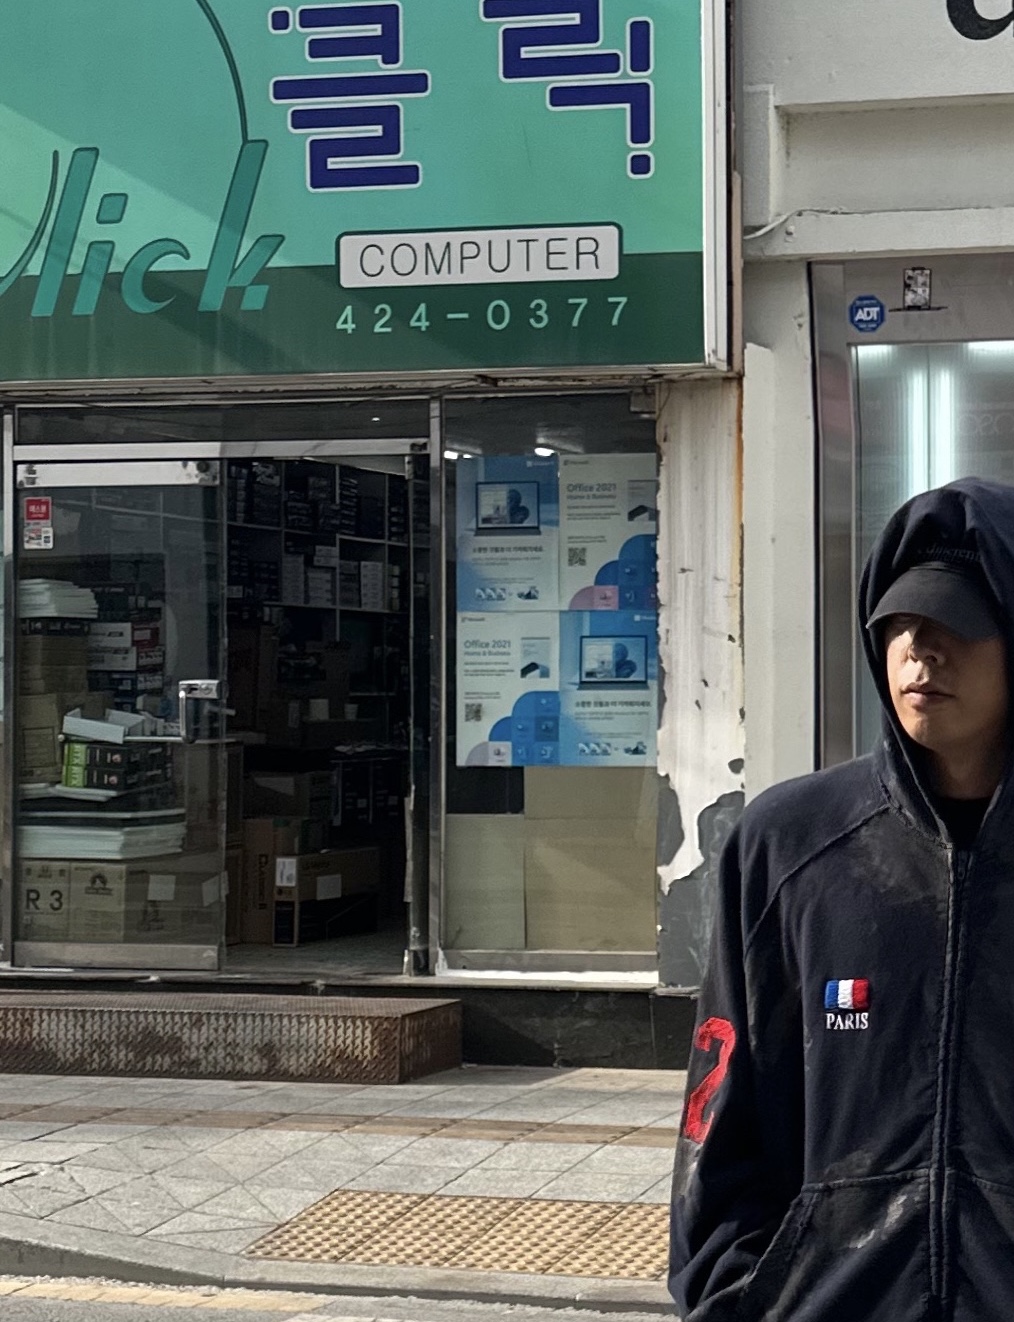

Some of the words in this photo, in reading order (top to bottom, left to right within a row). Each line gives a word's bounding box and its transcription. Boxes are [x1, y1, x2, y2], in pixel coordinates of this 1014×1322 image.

[0, 139, 285, 317] lick
[359, 236, 600, 278] COMPUTER
[335, 296, 628, 334] 424-0377
[855, 307, 880, 321] ADT
[566, 483, 594, 493] Office
[595, 483, 617, 493] 2021
[464, 640, 490, 649] Office
[491, 639, 511, 649] 2021
[825, 1012, 869, 1030] PARIS
